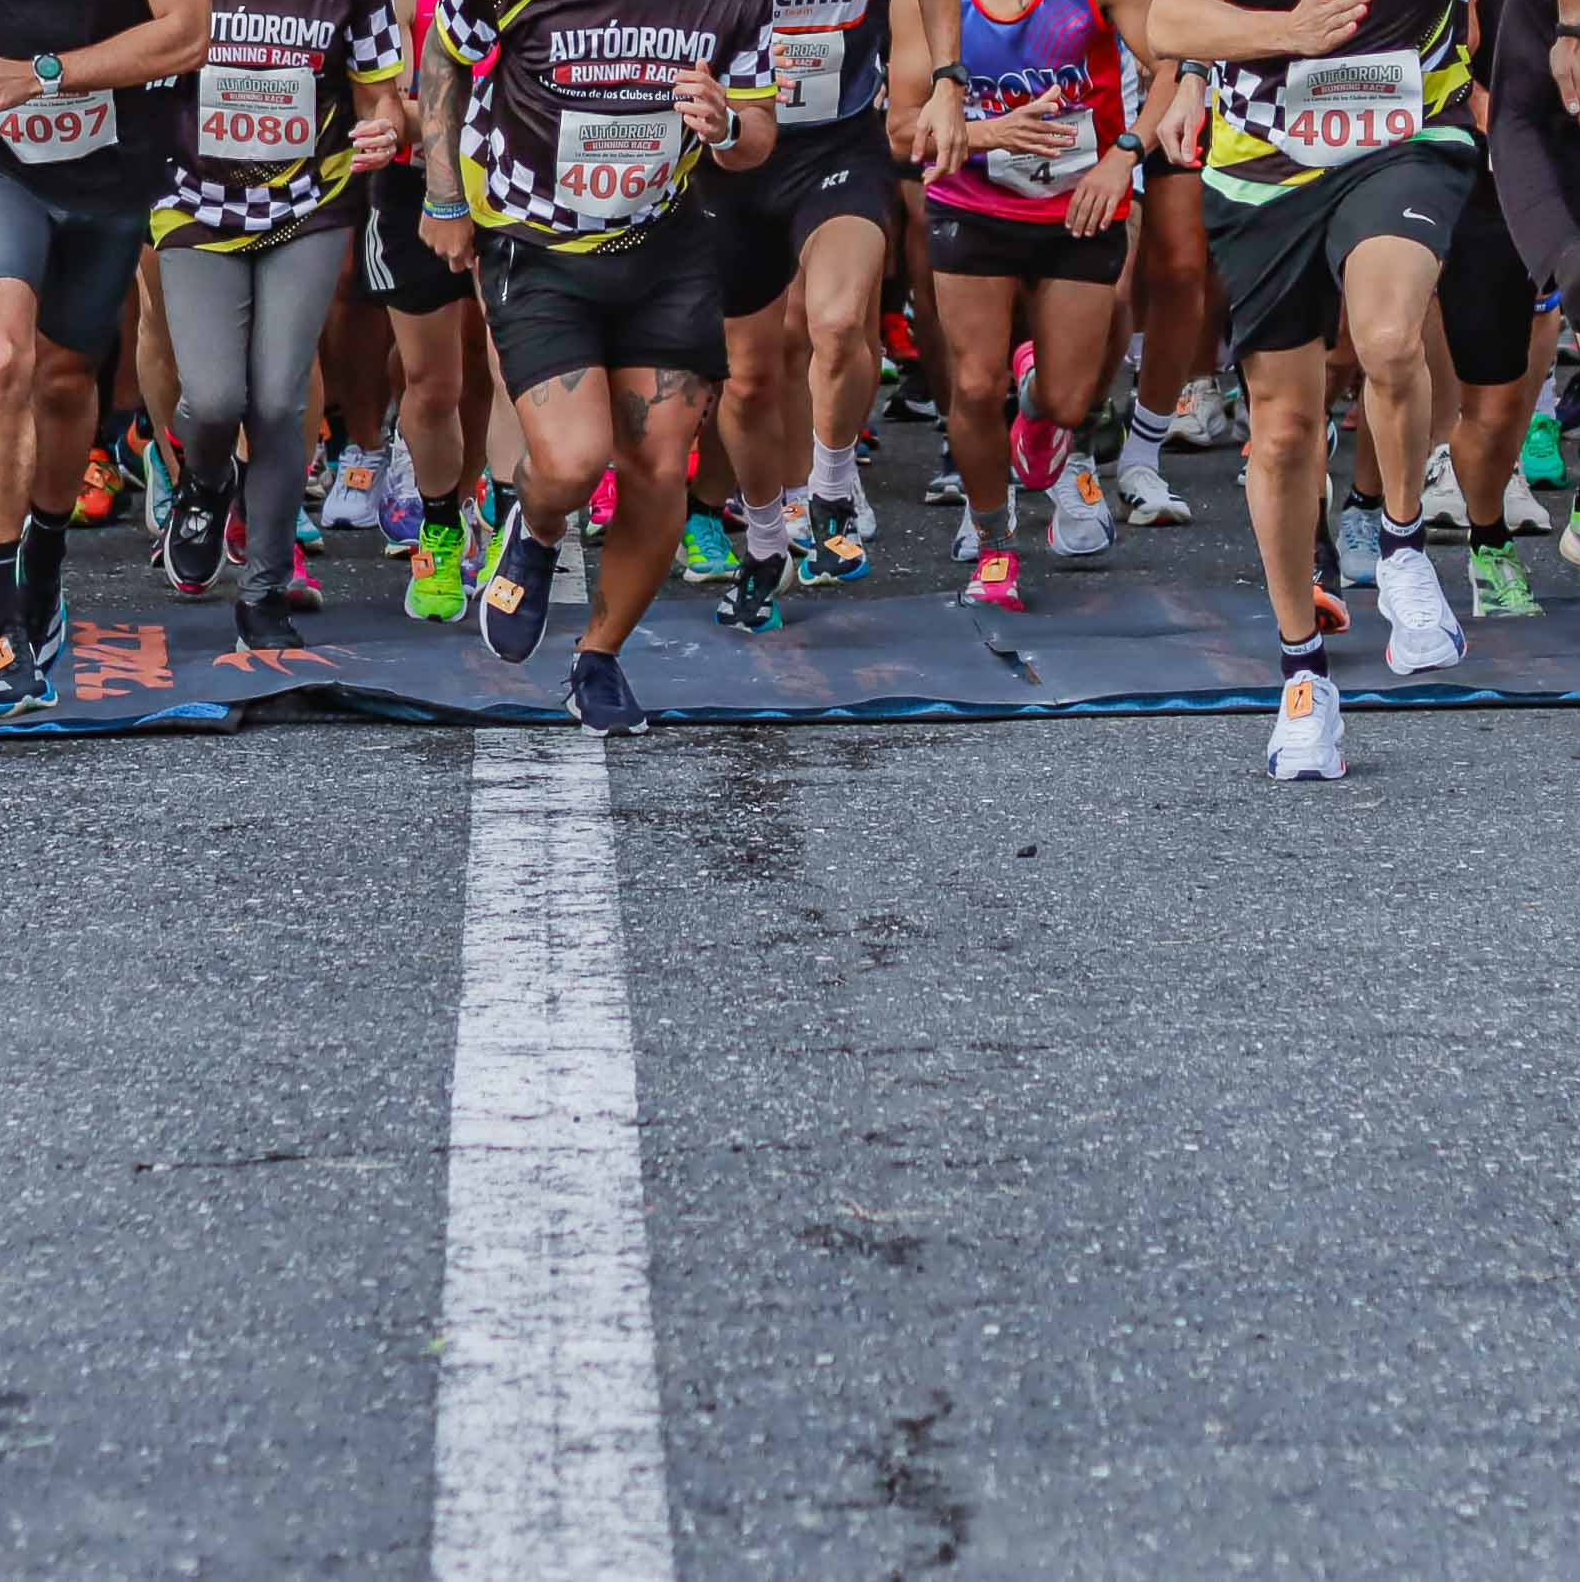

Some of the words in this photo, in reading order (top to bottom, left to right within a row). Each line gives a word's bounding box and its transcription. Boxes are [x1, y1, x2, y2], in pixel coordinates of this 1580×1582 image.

[210, 5, 335, 50] UTÓDROMO
[548, 19, 717, 62] AUTÓDROMO
[216, 75, 300, 94] AUTÓDROMO
[570, 63, 640, 84] RUNNING
[643, 63, 679, 83] RAC
[1307, 63, 1403, 88] AUTÓDROMO
[549, 83, 587, 98] Carrera
[589, 88, 602, 100] de
[603, 89, 617, 100] los
[619, 89, 654, 101] Clubes
[655, 90, 670, 102] del
[202, 111, 310, 146] 4080
[579, 121, 667, 140] AUTÓDROMO
[1287, 108, 1415, 147] 4019
[560, 161, 671, 199] 4064
